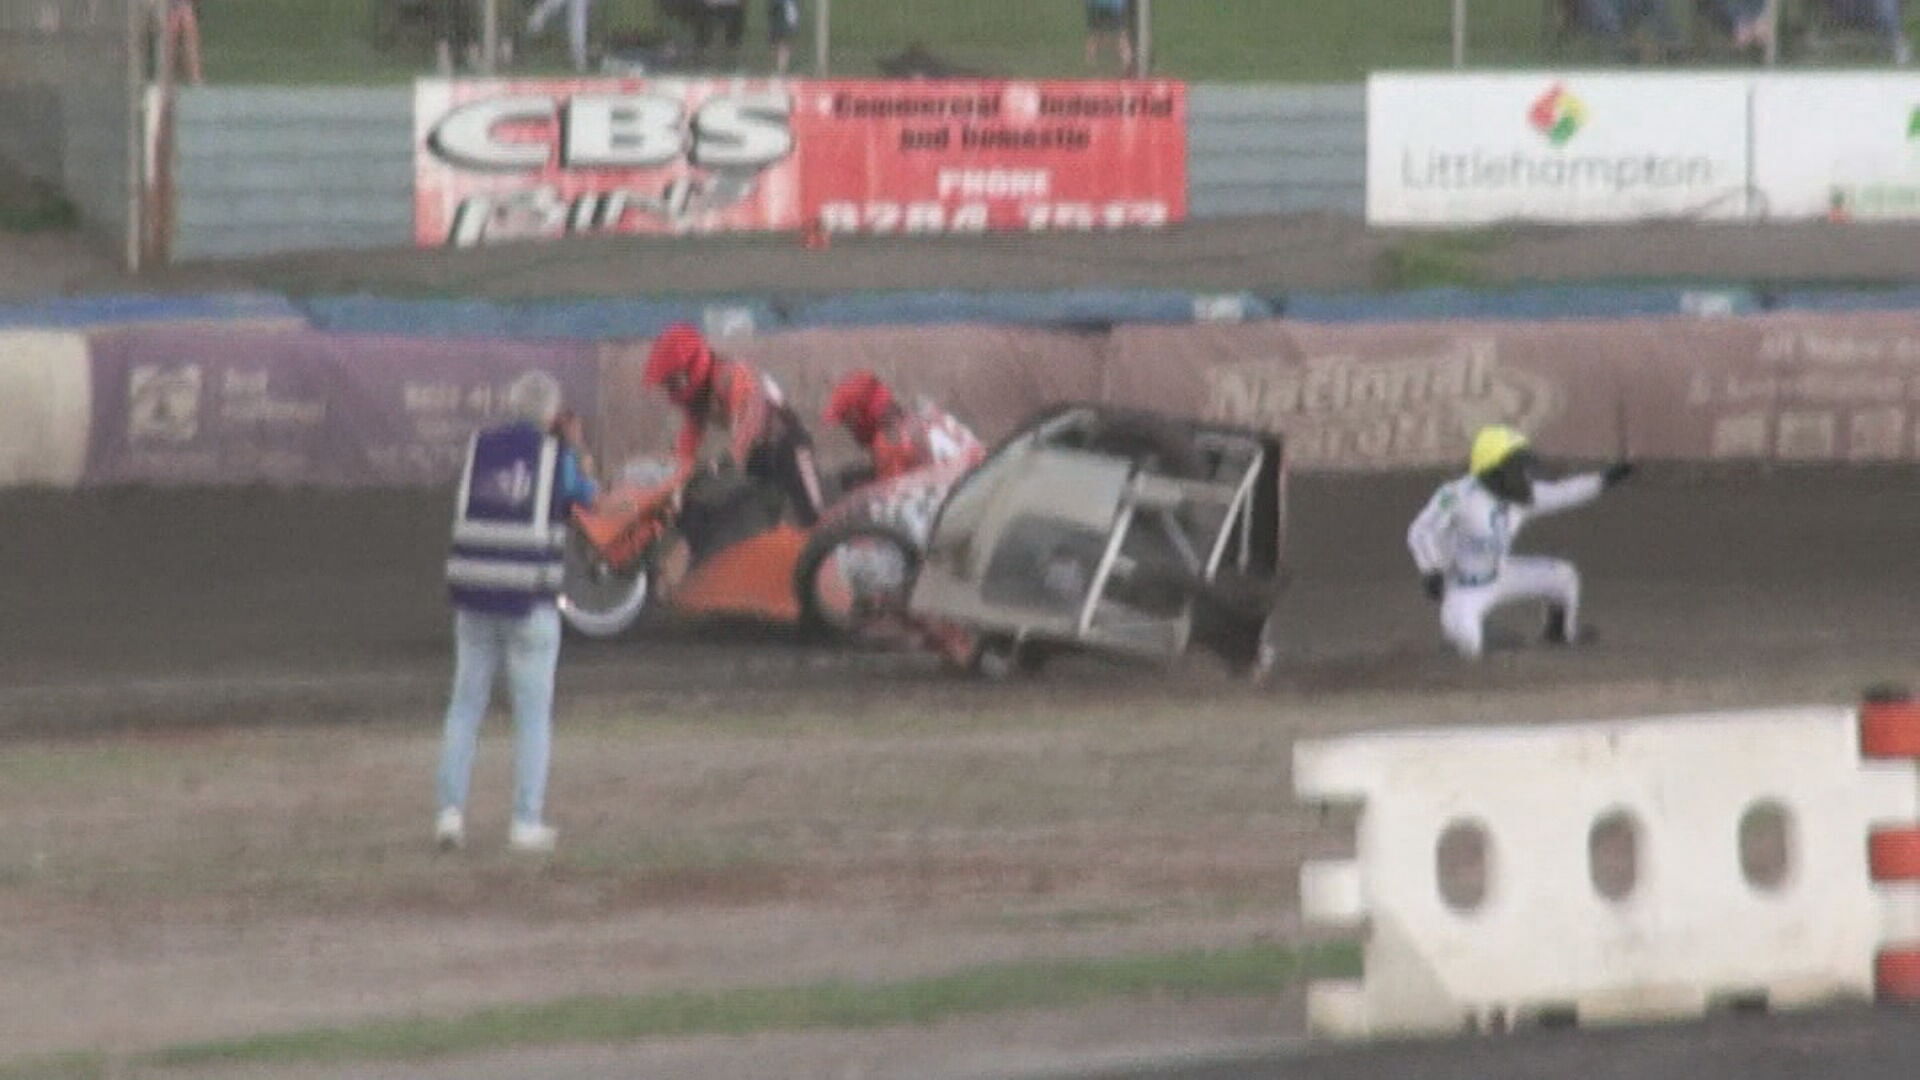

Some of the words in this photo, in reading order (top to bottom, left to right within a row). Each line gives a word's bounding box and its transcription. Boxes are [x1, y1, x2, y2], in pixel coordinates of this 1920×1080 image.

[1038, 92, 1173, 118] Industrial
[426, 92, 798, 172] CBS
[936, 168, 1049, 198] PHONE
[1401, 145, 1712, 191] Littlehampton
